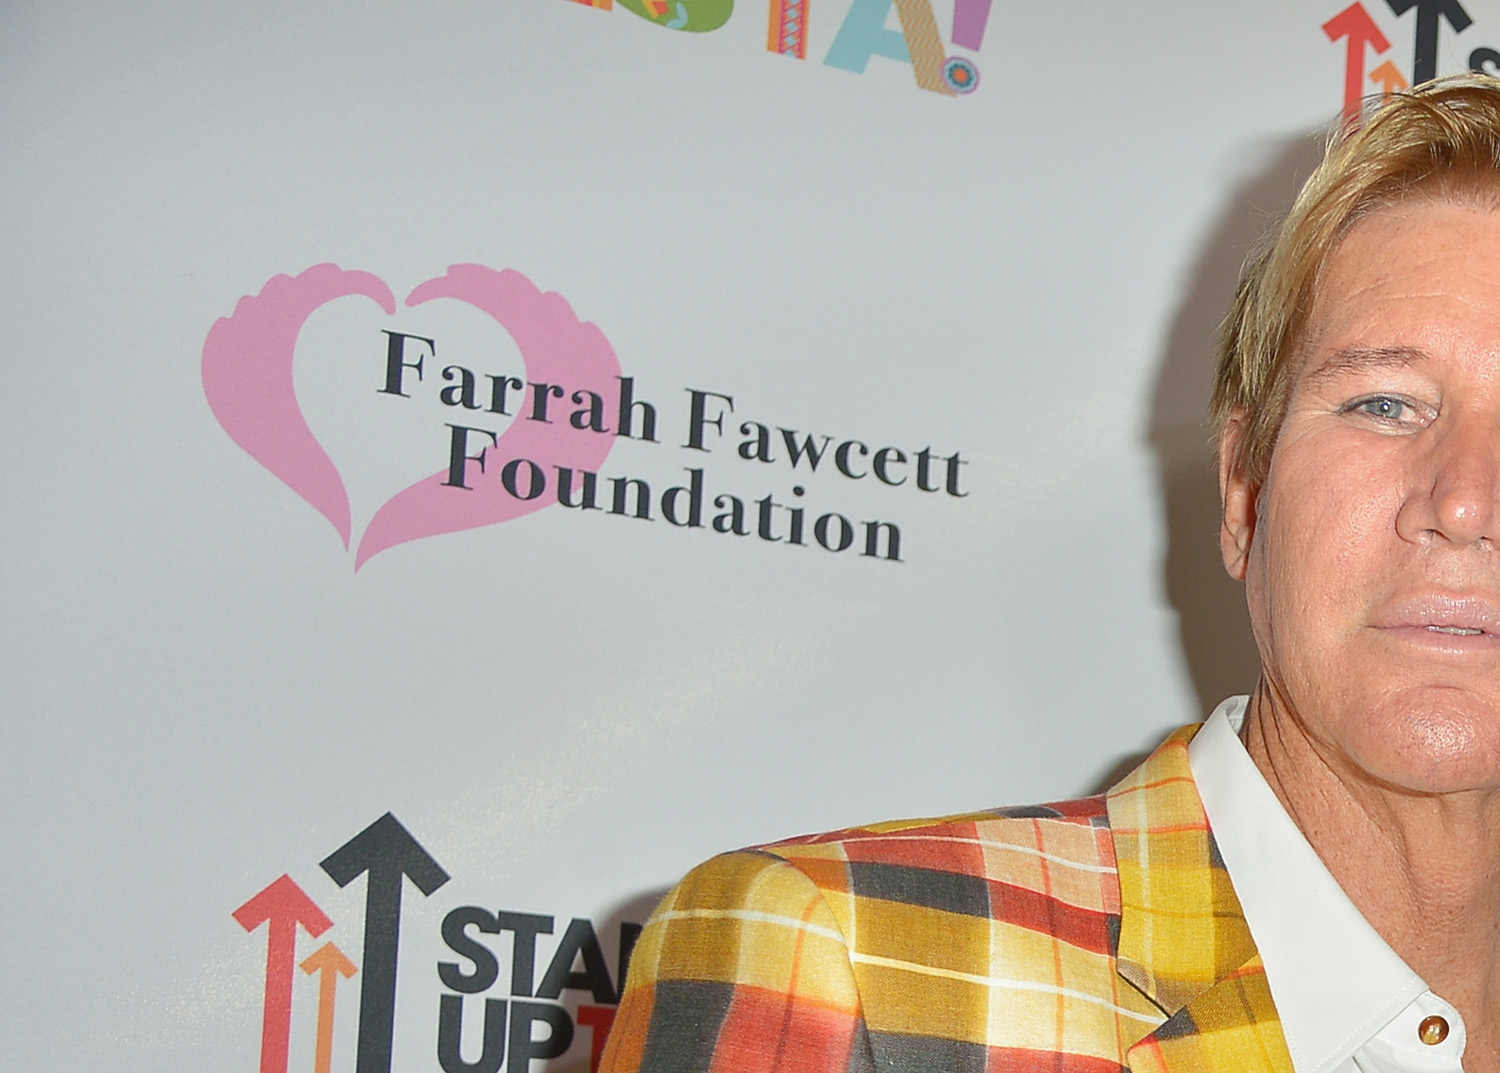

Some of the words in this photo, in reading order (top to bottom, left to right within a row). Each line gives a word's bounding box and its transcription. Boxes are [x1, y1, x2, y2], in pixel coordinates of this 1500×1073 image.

[377, 328, 661, 444] Farrah
[680, 388, 970, 498] Fawcett
[440, 423, 906, 562] Foundation
